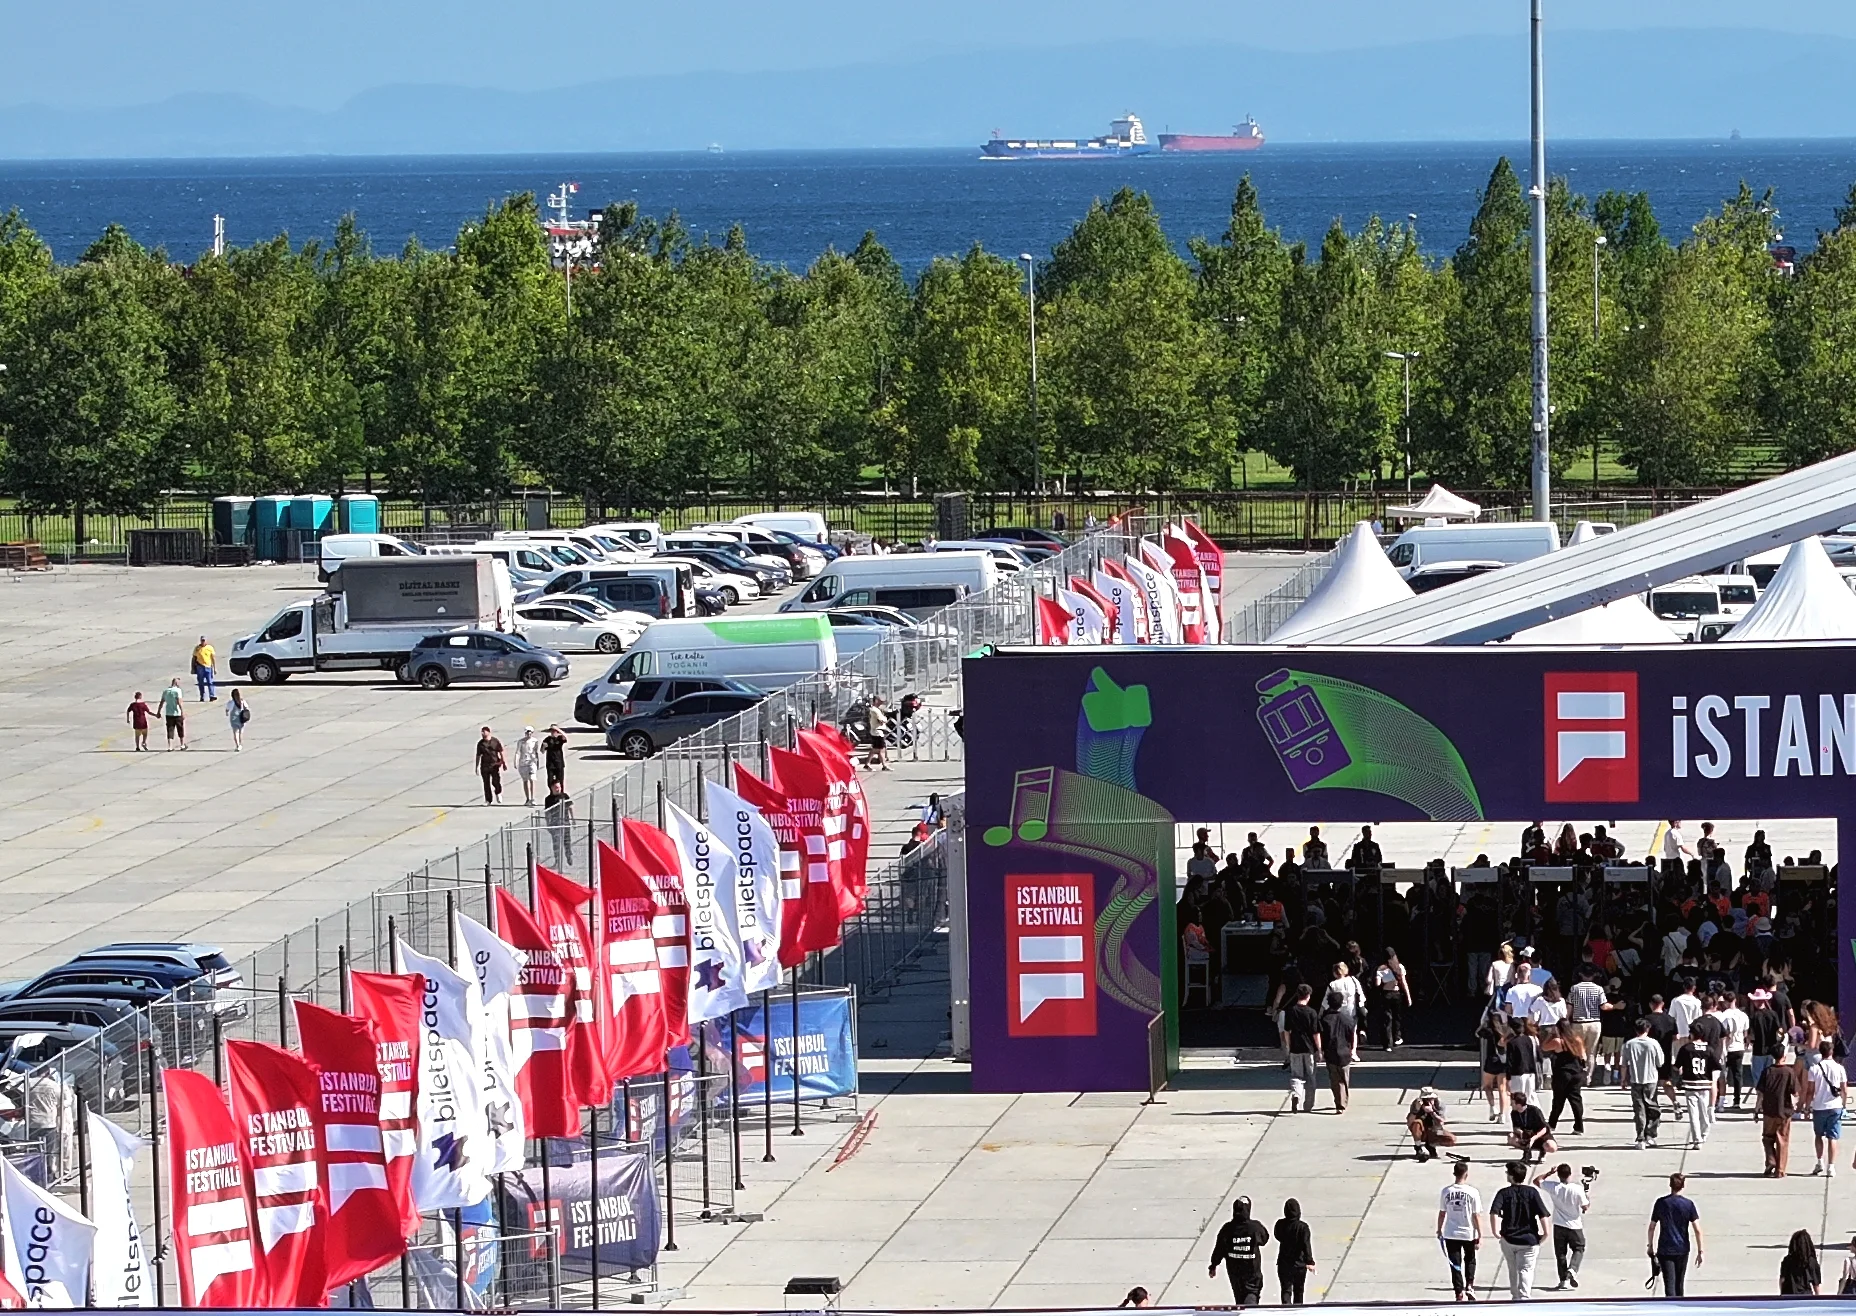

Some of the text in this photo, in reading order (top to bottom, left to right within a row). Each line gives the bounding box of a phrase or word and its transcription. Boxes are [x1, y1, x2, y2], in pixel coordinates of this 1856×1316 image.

[736, 810, 758, 929] biletspace
[695, 831, 715, 951] biletspace
[1017, 886, 1082, 905] iSTANBUL
[1017, 907, 1083, 926] FESTiVALi
[422, 977, 456, 1123] biletspace
[774, 1033, 827, 1057] iSTNBUL
[1692, 1057, 1706, 1075] 91
[571, 1195, 634, 1223] iSTNBUL
